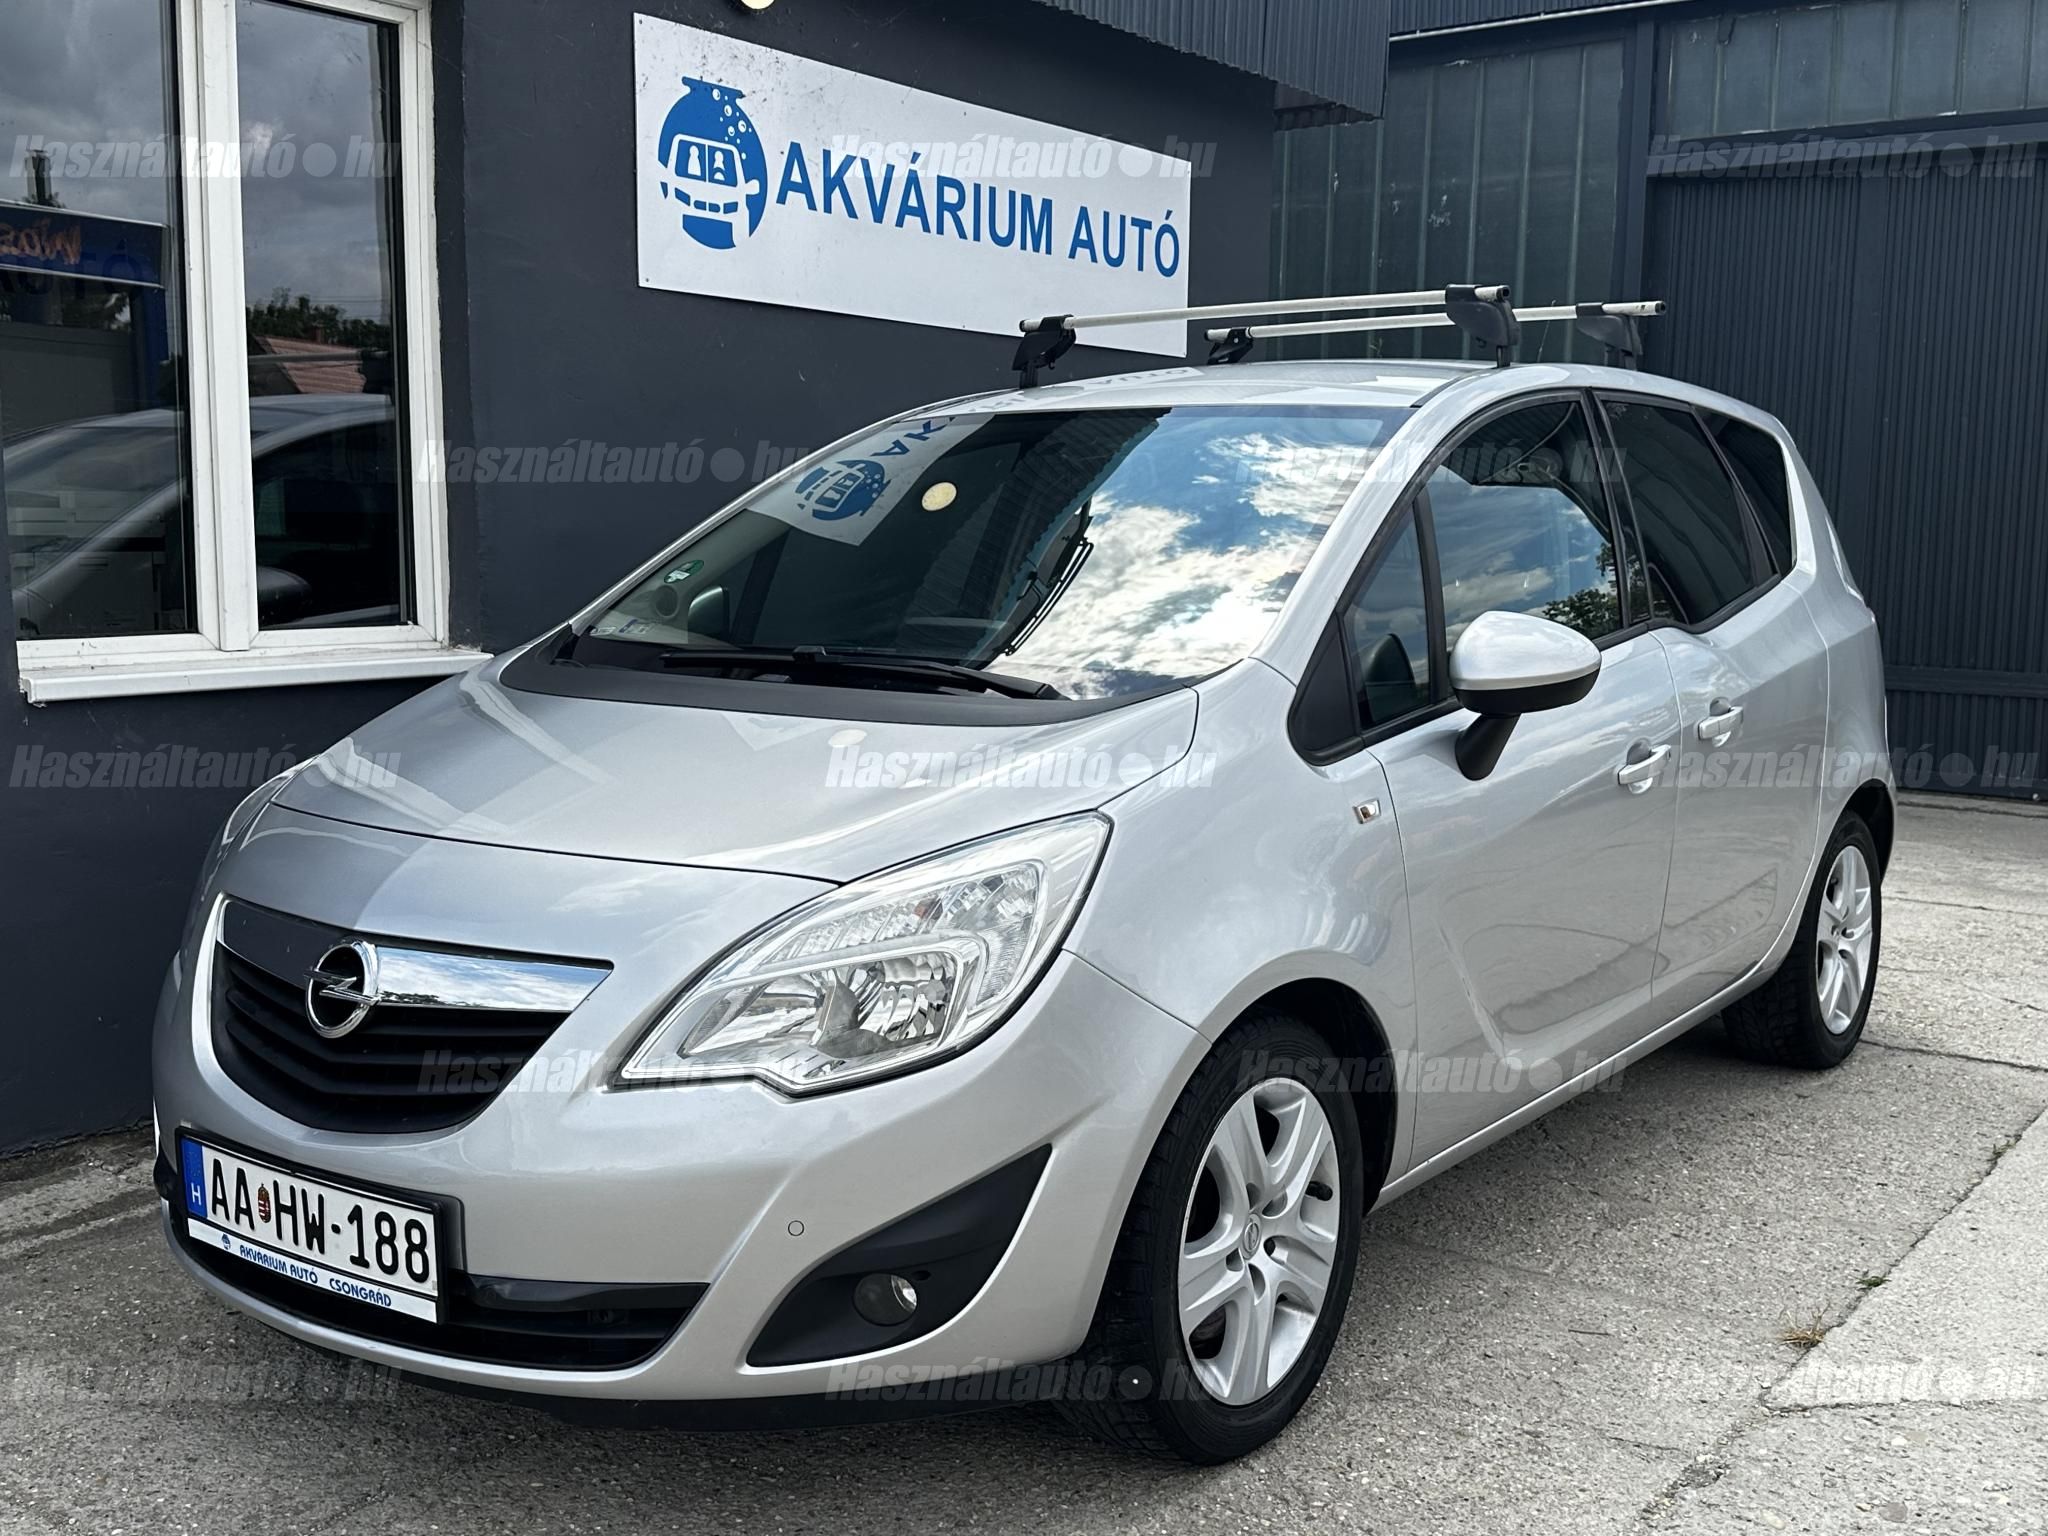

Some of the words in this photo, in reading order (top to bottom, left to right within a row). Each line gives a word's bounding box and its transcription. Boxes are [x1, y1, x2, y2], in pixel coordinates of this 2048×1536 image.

[776, 140, 1053, 256] AKVÁRIUM
[1067, 209, 1180, 278] AUTÓ
[190, 1182, 202, 1206] H
[239, 1244, 287, 1273] AKVÁRIUM
[289, 1263, 318, 1285] AUTÓ
[329, 1276, 392, 1307] CSONGRÁD
